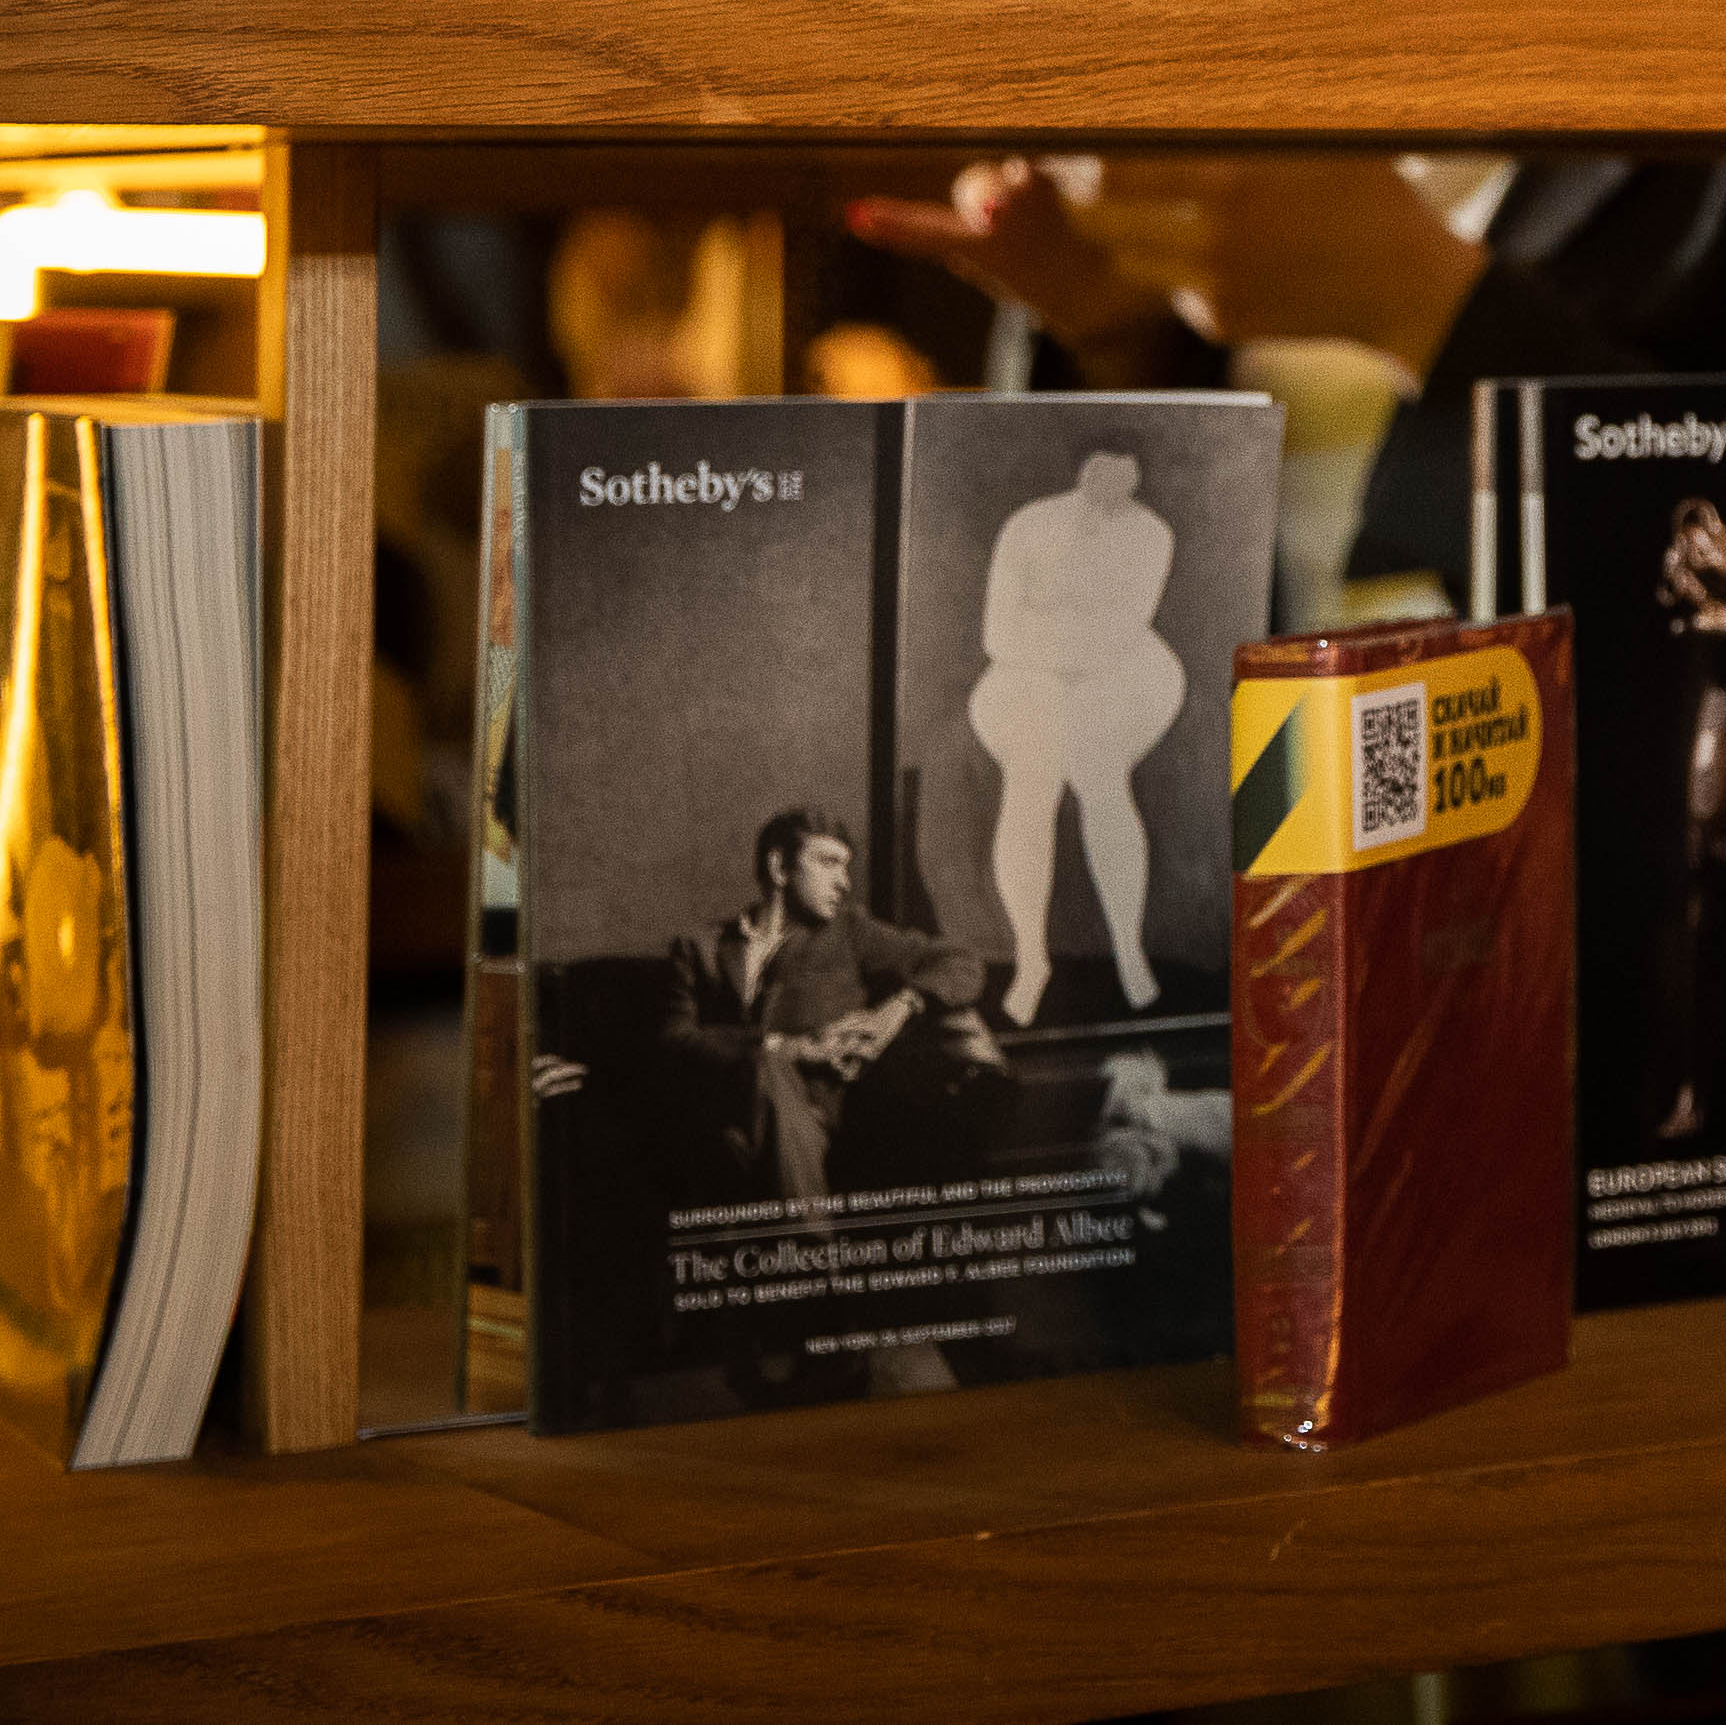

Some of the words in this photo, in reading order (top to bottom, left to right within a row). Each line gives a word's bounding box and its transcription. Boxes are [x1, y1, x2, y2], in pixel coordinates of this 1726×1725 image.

[578, 458, 775, 513] Sotheby's
[669, 1201, 784, 1230] SURROUNDED
[785, 1196, 810, 1218] BY
[812, 1192, 846, 1215] THE
[847, 1185, 938, 1212] BEAUTIFUL
[940, 1180, 979, 1203] AND
[980, 1176, 1013, 1199] THE
[1587, 1159, 1712, 1199] EUROPEAN
[667, 1249, 729, 1285] The
[734, 1237, 889, 1279] Collection
[891, 1225, 928, 1262] of
[932, 1213, 1046, 1259] Edward
[1048, 1209, 1136, 1248] Albee
[674, 1290, 724, 1313] SOLD
[726, 1285, 752, 1307] TO
[753, 1277, 829, 1305] BENEFIT
[830, 1272, 866, 1295] THE
[868, 1264, 943, 1293] EDWARD
[965, 1256, 1020, 1282] ALBEE
[1022, 1247, 1137, 1276] FOUNDATION
